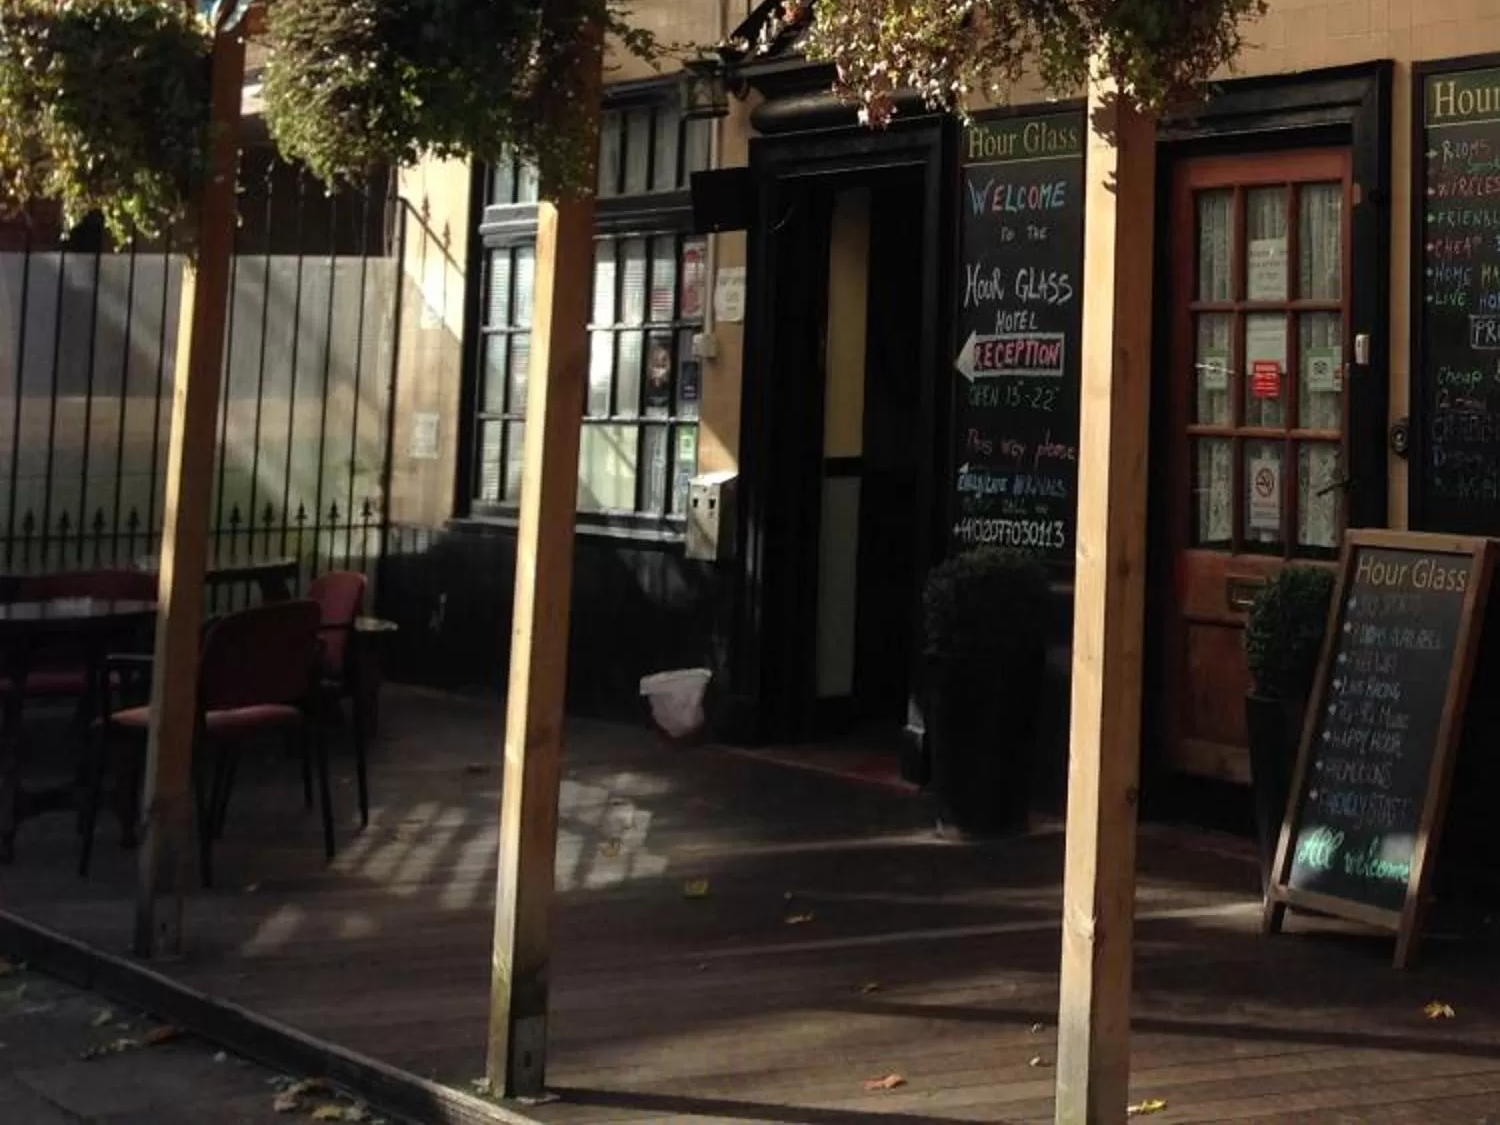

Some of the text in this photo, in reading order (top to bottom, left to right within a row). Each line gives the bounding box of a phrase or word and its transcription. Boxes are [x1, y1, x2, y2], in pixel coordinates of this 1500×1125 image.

[967, 122, 1077, 158] Hour Glass
[967, 179, 1068, 215] WELCOME
[1015, 266, 1073, 306] GLASS
[1435, 262, 1473, 288] HOME
[1435, 287, 1468, 306] LIVE
[996, 310, 1038, 332] HOTEL
[973, 339, 1060, 369] RECEPTION
[1355, 554, 1467, 592] Hour Glass
